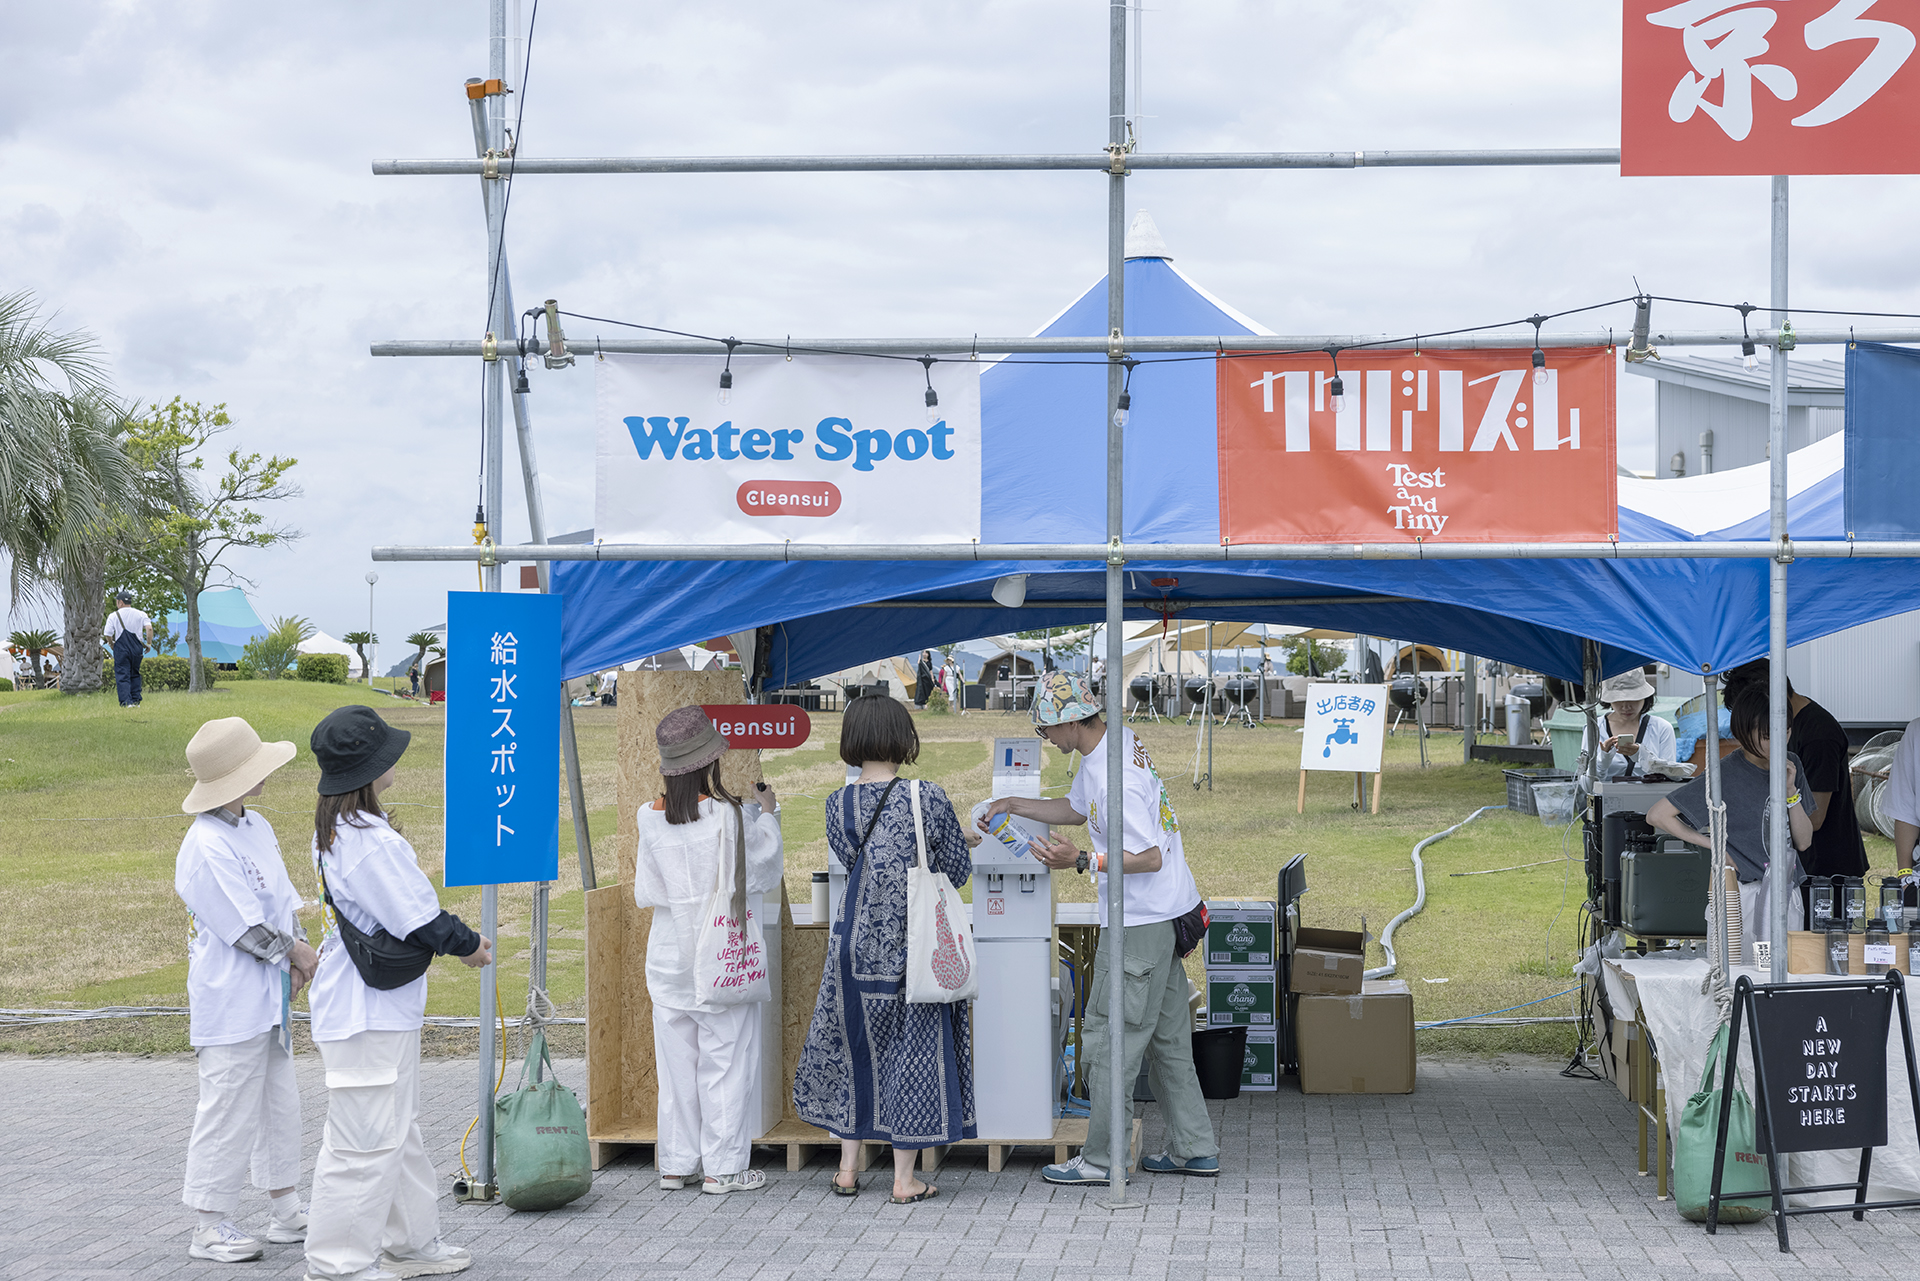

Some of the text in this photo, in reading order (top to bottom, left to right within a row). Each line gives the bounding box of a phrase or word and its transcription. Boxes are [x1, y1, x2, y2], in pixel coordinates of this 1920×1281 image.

[1250, 369, 1581, 452] カクバリズム
[623, 416, 955, 472] Water Spot
[1385, 463, 1447, 489] Test
[745, 489, 831, 509] Cleansui
[1396, 486, 1438, 513] and
[1386, 505, 1450, 536] Tiny
[1316, 694, 1376, 717] 出店者用
[712, 716, 796, 736] leansui
[489, 631, 519, 847] 給水スポット
[1226, 933, 1254, 945] Chang
[713, 967, 766, 988] I LOVE YOU
[1227, 993, 1255, 1005] Chang
[1816, 1015, 1828, 1033] A
[1802, 1038, 1842, 1057] NEW
[1805, 1061, 1839, 1080] DAY
[1787, 1083, 1858, 1104] STARTS
[1799, 1106, 1846, 1127] HERE
[535, 1126, 569, 1135] RENT
